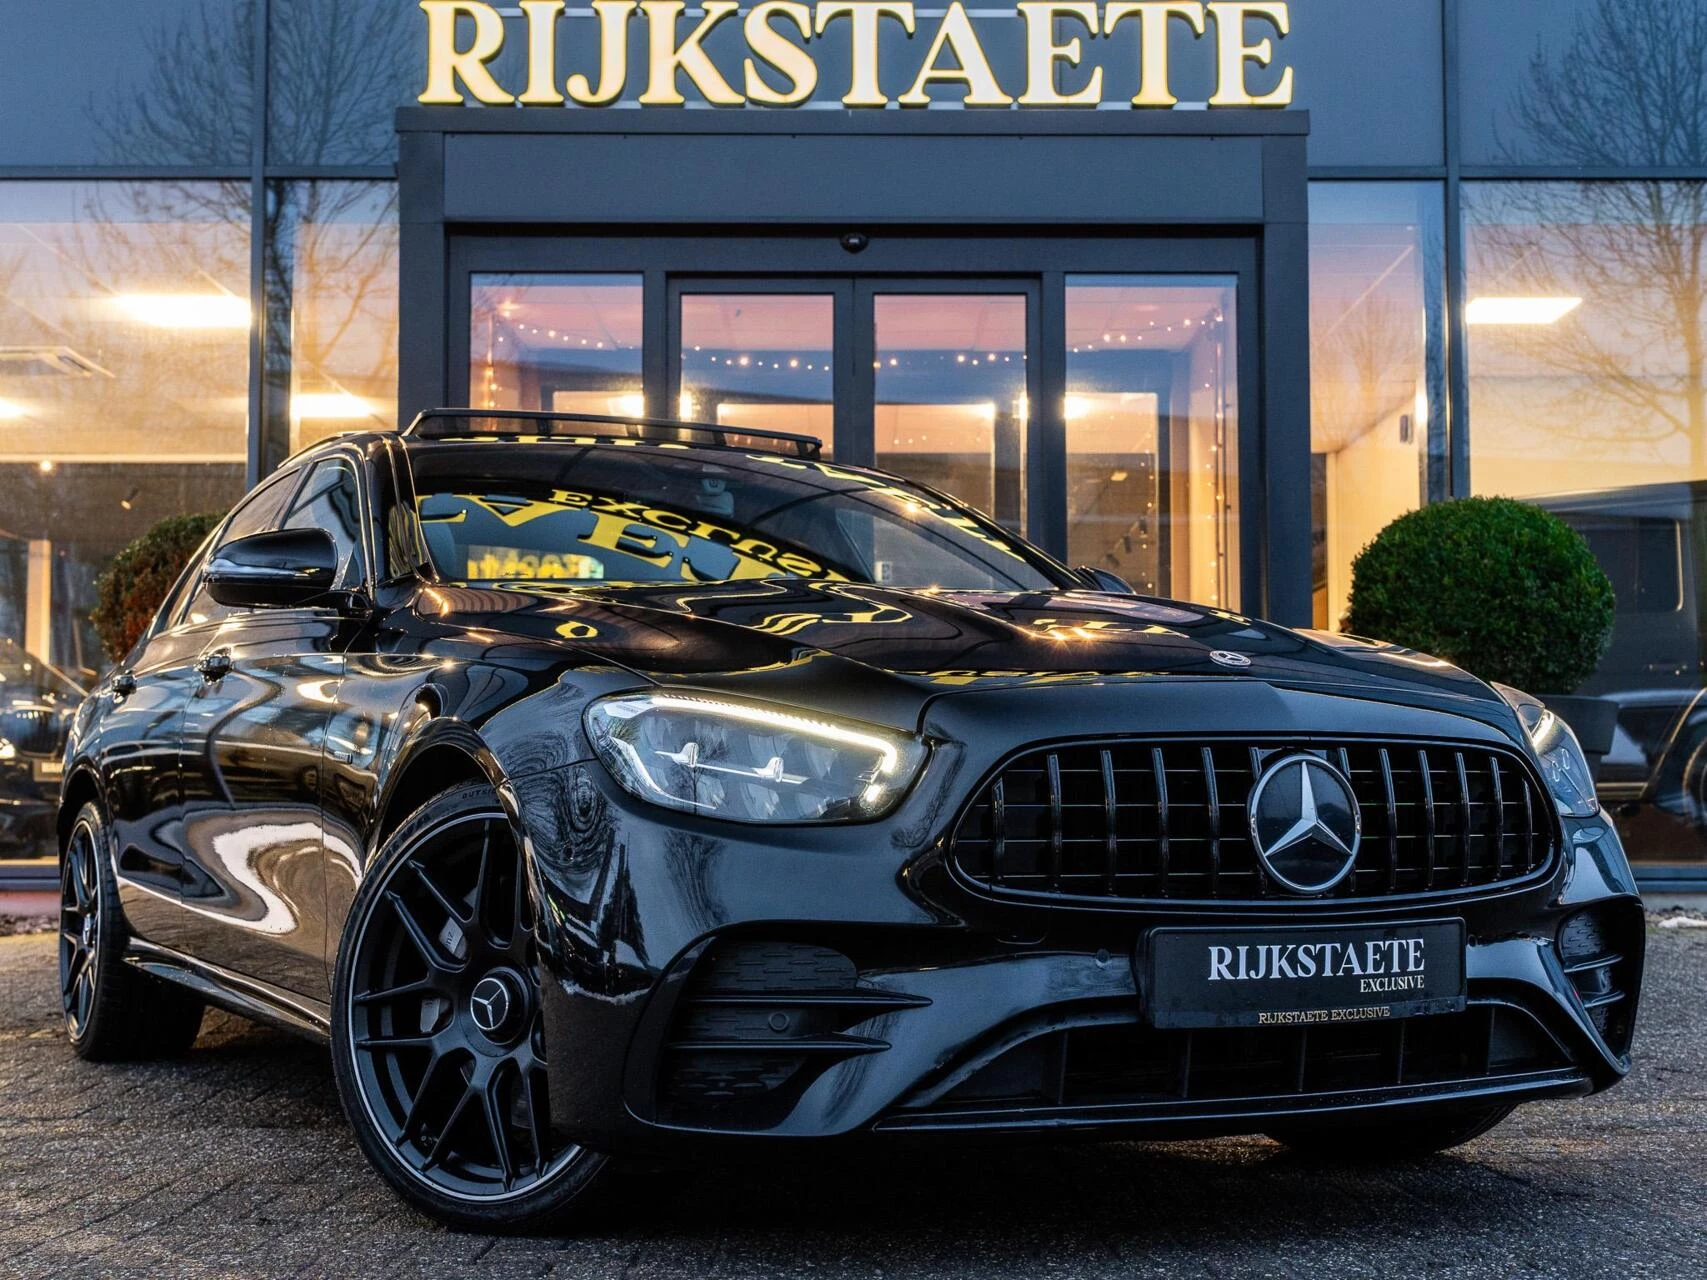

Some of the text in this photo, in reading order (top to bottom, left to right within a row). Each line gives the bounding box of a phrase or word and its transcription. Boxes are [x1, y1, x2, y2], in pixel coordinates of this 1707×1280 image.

[417, 0, 1294, 106] RIJKSTAETE
[1208, 938, 1426, 981] RIJKSTAETE
[1360, 975, 1425, 993] EXCLUSIVE
[1258, 1006, 1390, 1025] RIJKSTAETE EXCLUSIVE
